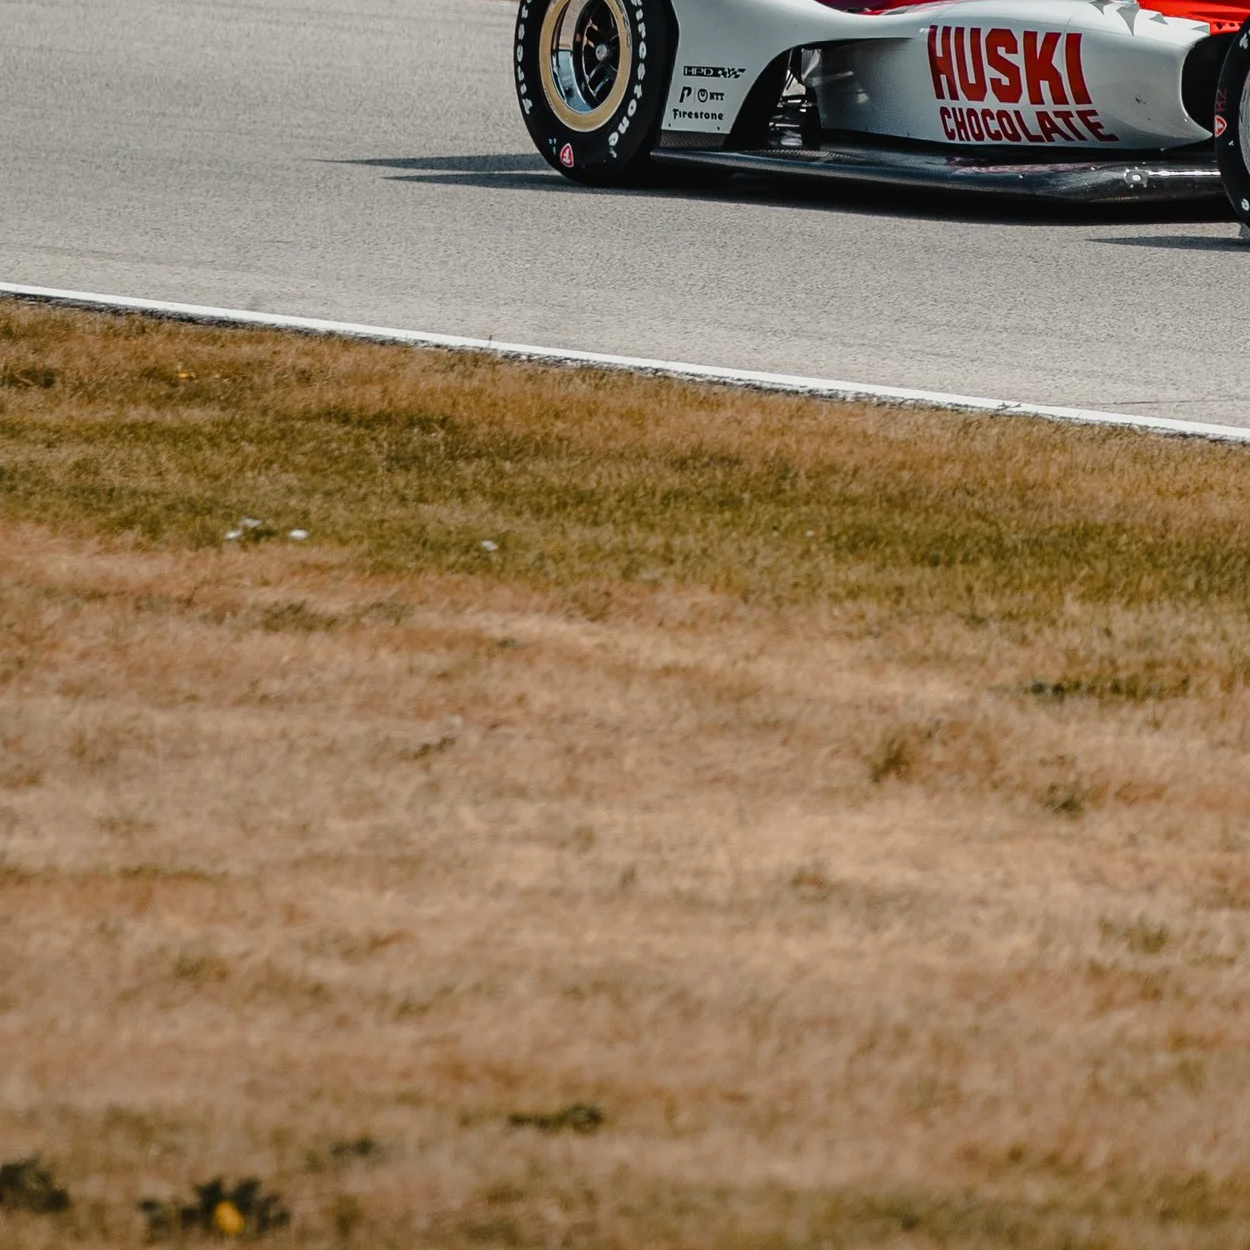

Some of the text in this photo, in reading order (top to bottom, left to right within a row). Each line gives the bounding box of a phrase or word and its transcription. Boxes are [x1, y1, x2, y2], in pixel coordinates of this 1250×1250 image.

[928, 25, 1092, 105] HUSKI
[672, 108, 724, 120] Firestone
[939, 106, 1121, 143] CHOCOLATE
